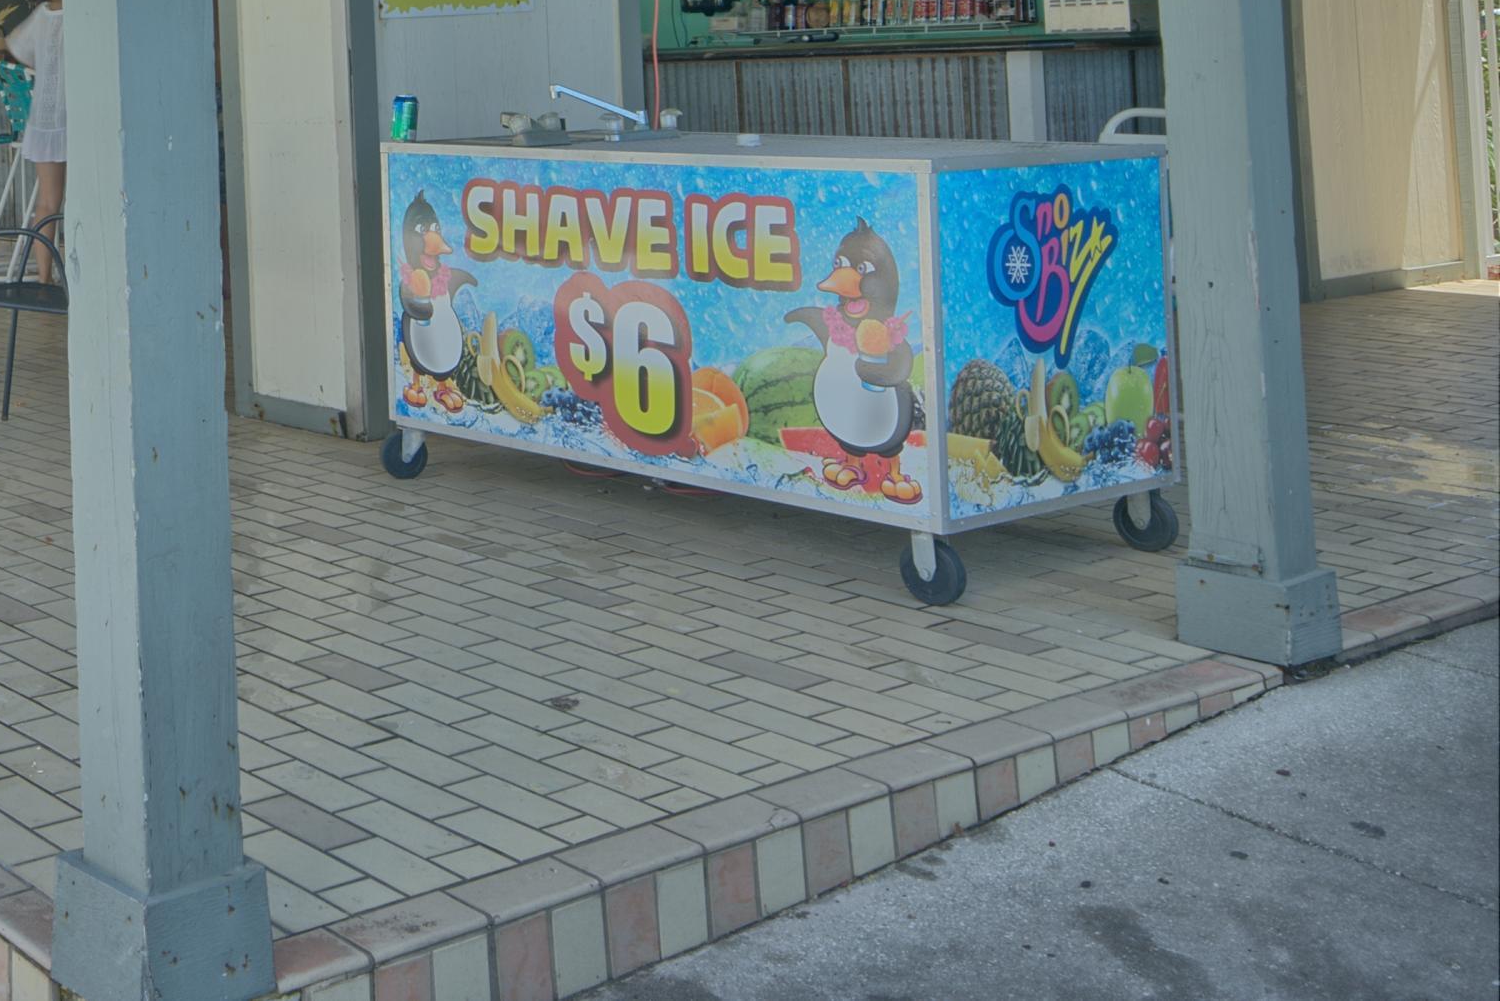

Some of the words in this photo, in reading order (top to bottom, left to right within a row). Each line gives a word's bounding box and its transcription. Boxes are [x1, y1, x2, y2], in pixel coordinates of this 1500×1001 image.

[467, 186, 672, 270] SHAVE
[691, 202, 794, 281] ICE
[994, 193, 1070, 301] Sno
[569, 292, 675, 435] $6
